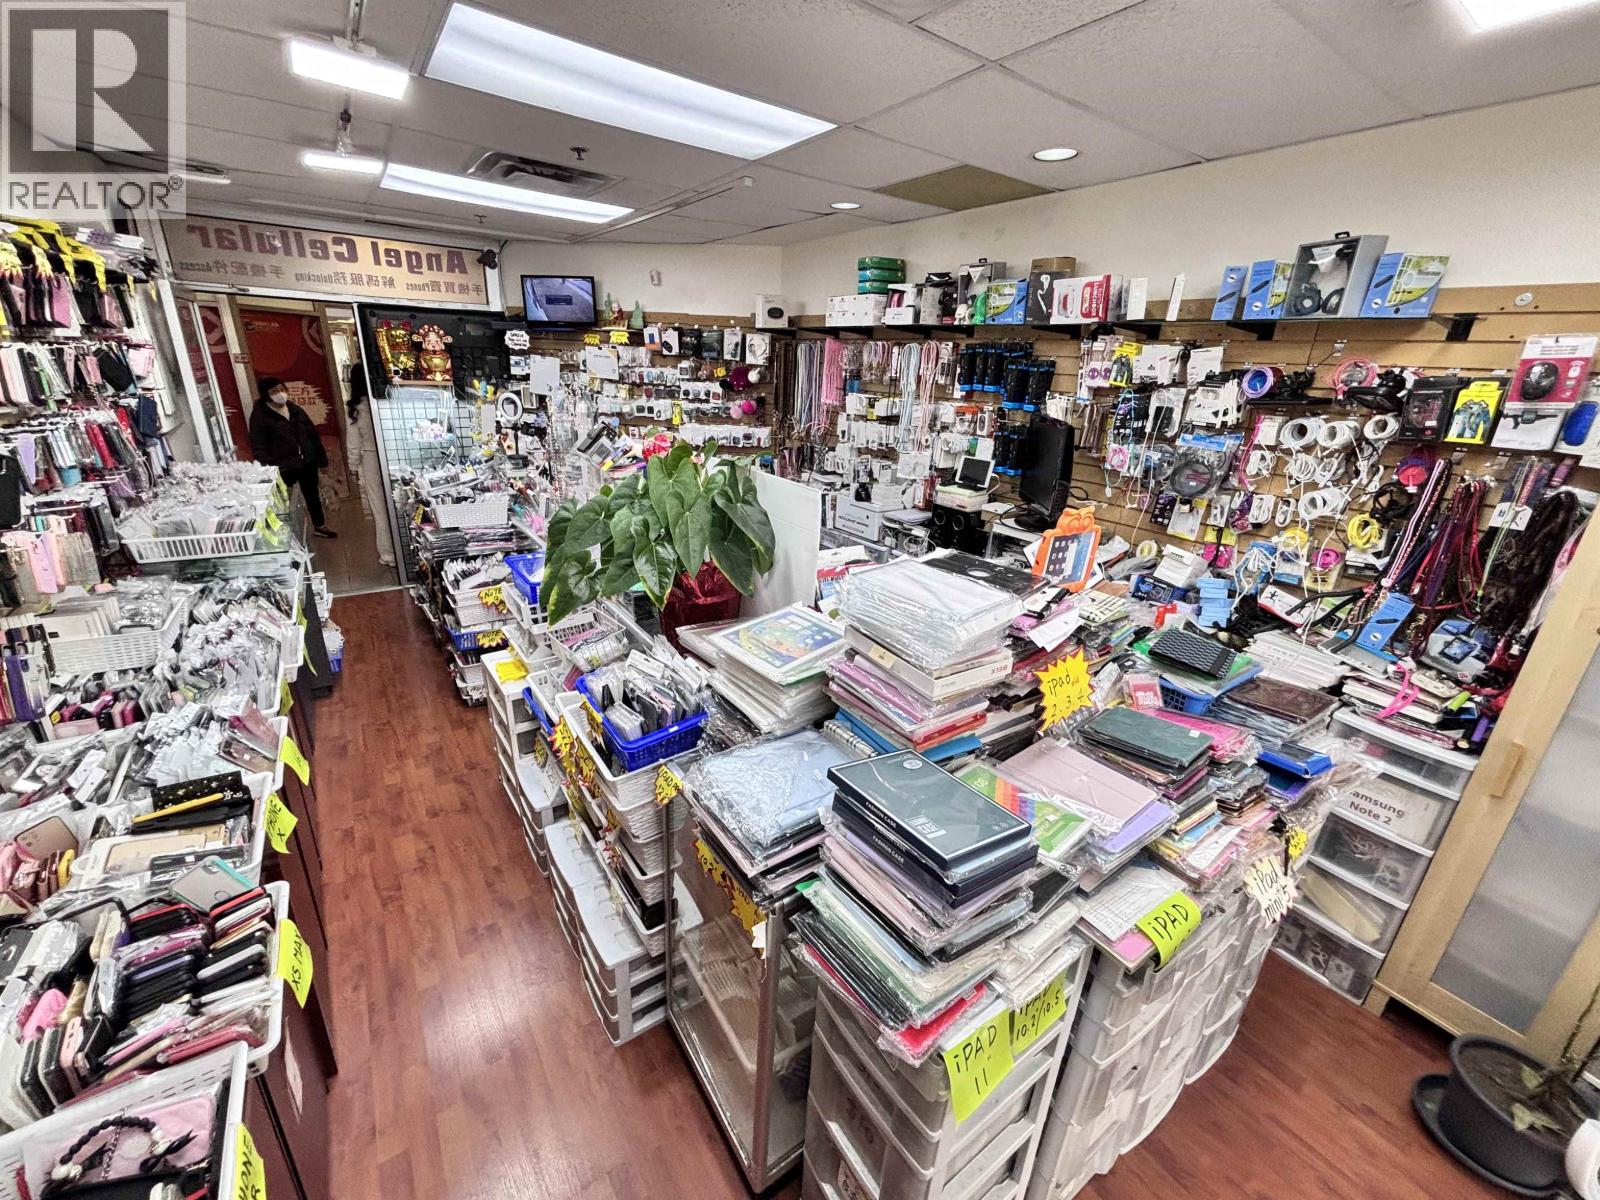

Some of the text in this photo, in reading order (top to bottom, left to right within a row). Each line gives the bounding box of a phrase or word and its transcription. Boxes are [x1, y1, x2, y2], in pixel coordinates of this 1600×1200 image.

[1047, 668, 1070, 697] iPad
[1349, 801, 1392, 826] Note 2
[1350, 790, 1405, 818] amsung
[1253, 858, 1279, 895] iPad
[1147, 903, 1189, 942] iPAD
[291, 965, 301, 991] XS
[953, 1024, 997, 1074] iPAD
